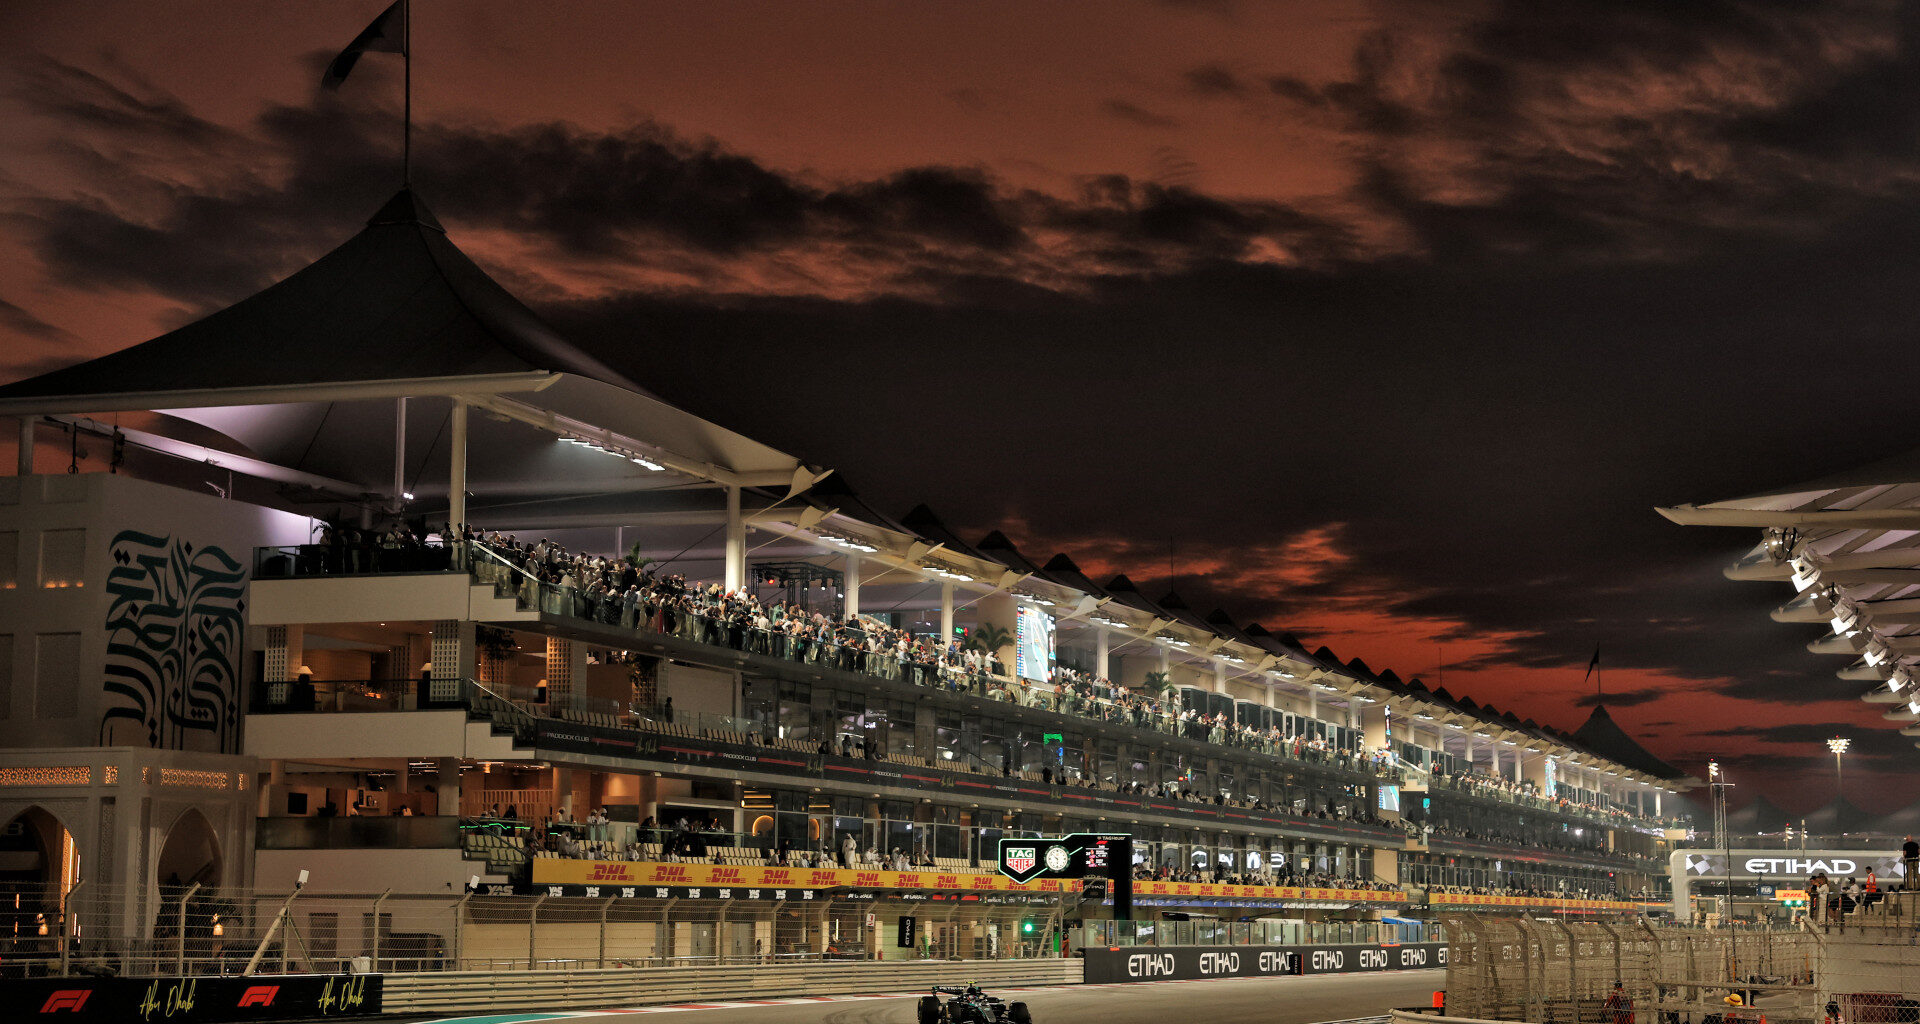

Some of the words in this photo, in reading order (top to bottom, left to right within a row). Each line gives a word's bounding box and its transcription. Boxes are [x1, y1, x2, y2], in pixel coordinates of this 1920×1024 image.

[1009, 849, 1033, 858] TAG
[1008, 859, 1034, 872] HEUER
[1745, 858, 1857, 875] ETIHAD
[593, 864, 629, 881] DHL
[655, 866, 688, 882] DHL
[711, 867, 740, 884] DHL
[763, 869, 790, 885] DHL
[811, 871, 837, 886] DHL
[856, 872, 880, 887] DHL
[897, 874, 921, 888] DHL
[937, 875, 958, 889] DHL
[973, 876, 994, 890] DHL
[487, 885, 514, 896] YAS
[549, 886, 563, 897] YAS
[1128, 953, 1175, 977] ETIHAD
[1199, 952, 1240, 974] ETIHAD
[1312, 950, 1344, 969] ETIHAD
[1360, 949, 1388, 968] ETIHAD
[1401, 948, 1426, 966] ETIHAD
[139, 979, 161, 1022] Abu
[165, 978, 197, 1018] Dhabi
[317, 976, 336, 1015] Abu
[340, 975, 366, 1011] Dhabi
